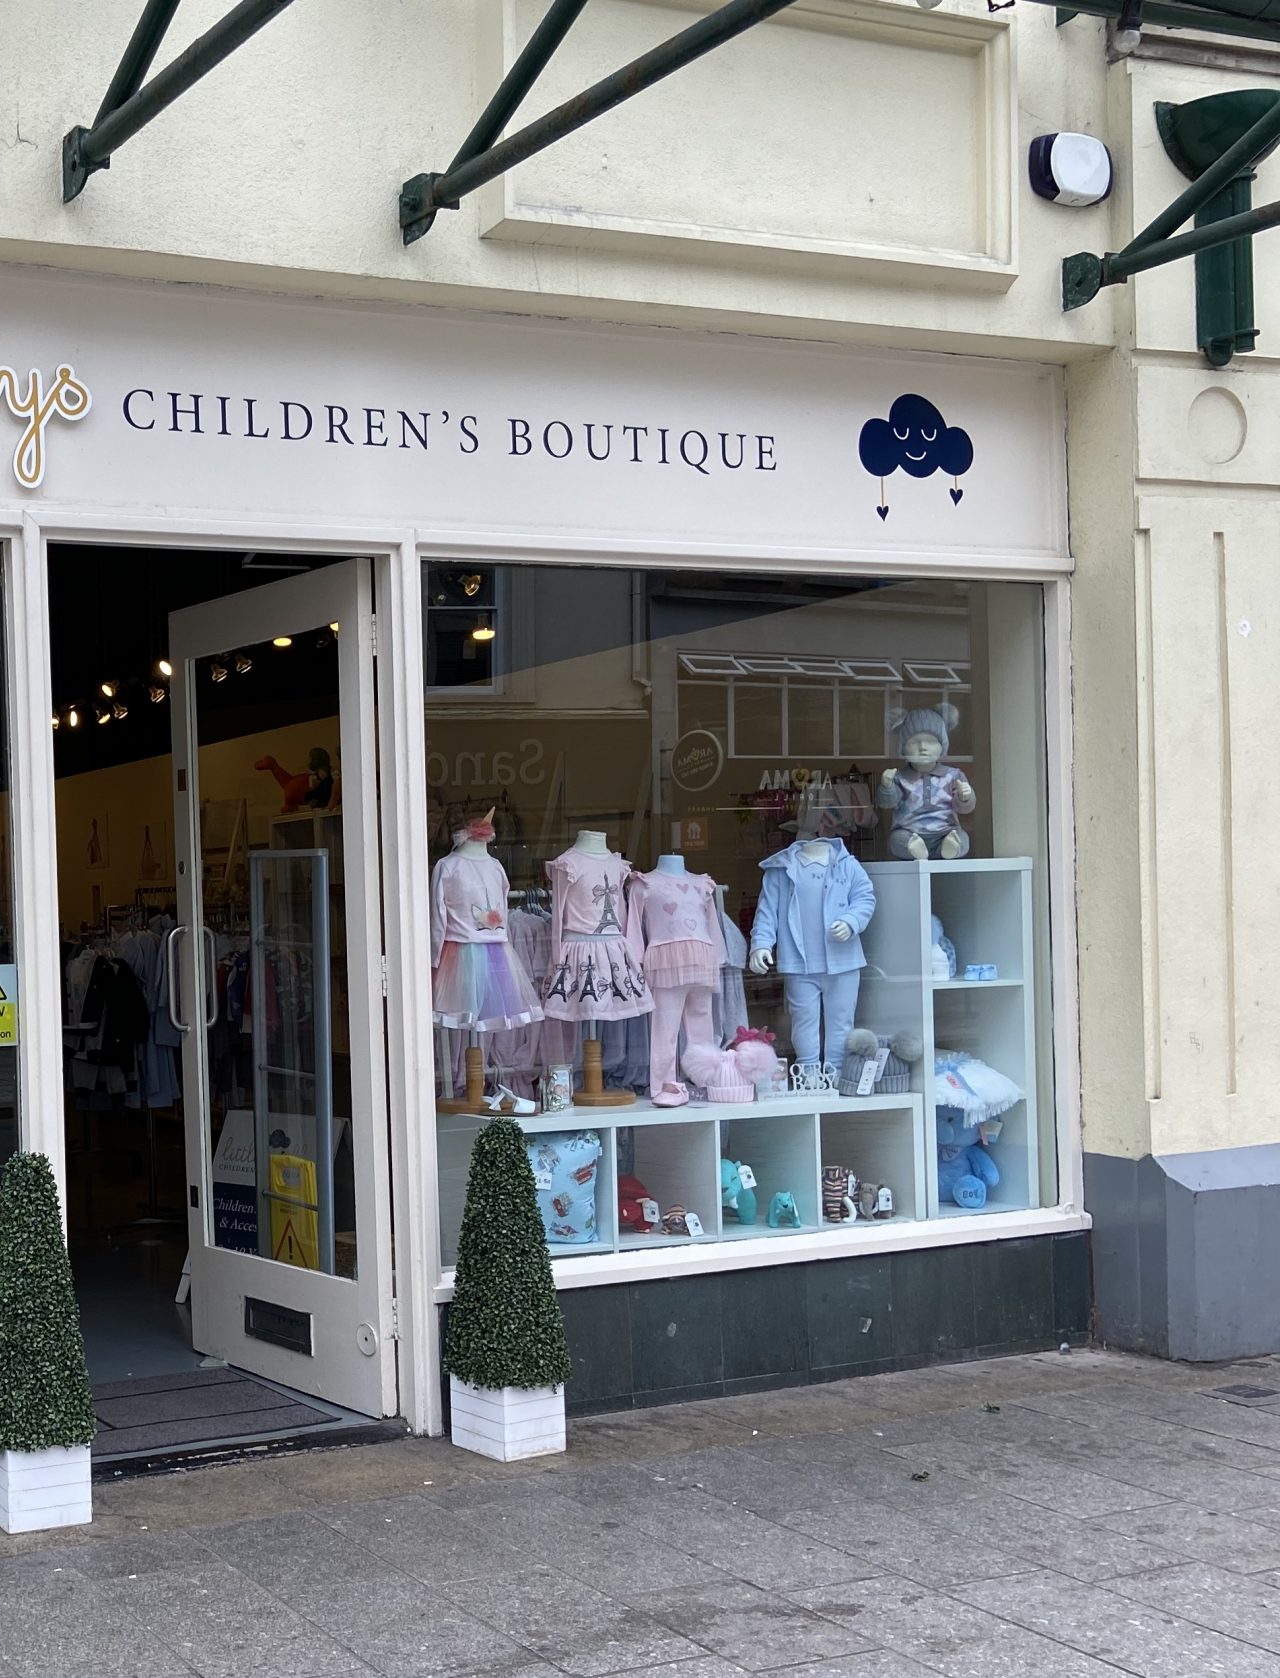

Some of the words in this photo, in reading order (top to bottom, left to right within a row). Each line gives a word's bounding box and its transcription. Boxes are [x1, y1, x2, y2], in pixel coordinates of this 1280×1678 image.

[121, 388, 480, 454] CHILDREN'S
[507, 417, 778, 475] BOUTIQUE
[789, 1062, 823, 1077] OUR
[791, 1074, 836, 1092] BABY
[218, 1163, 255, 1174] CHILDREN
